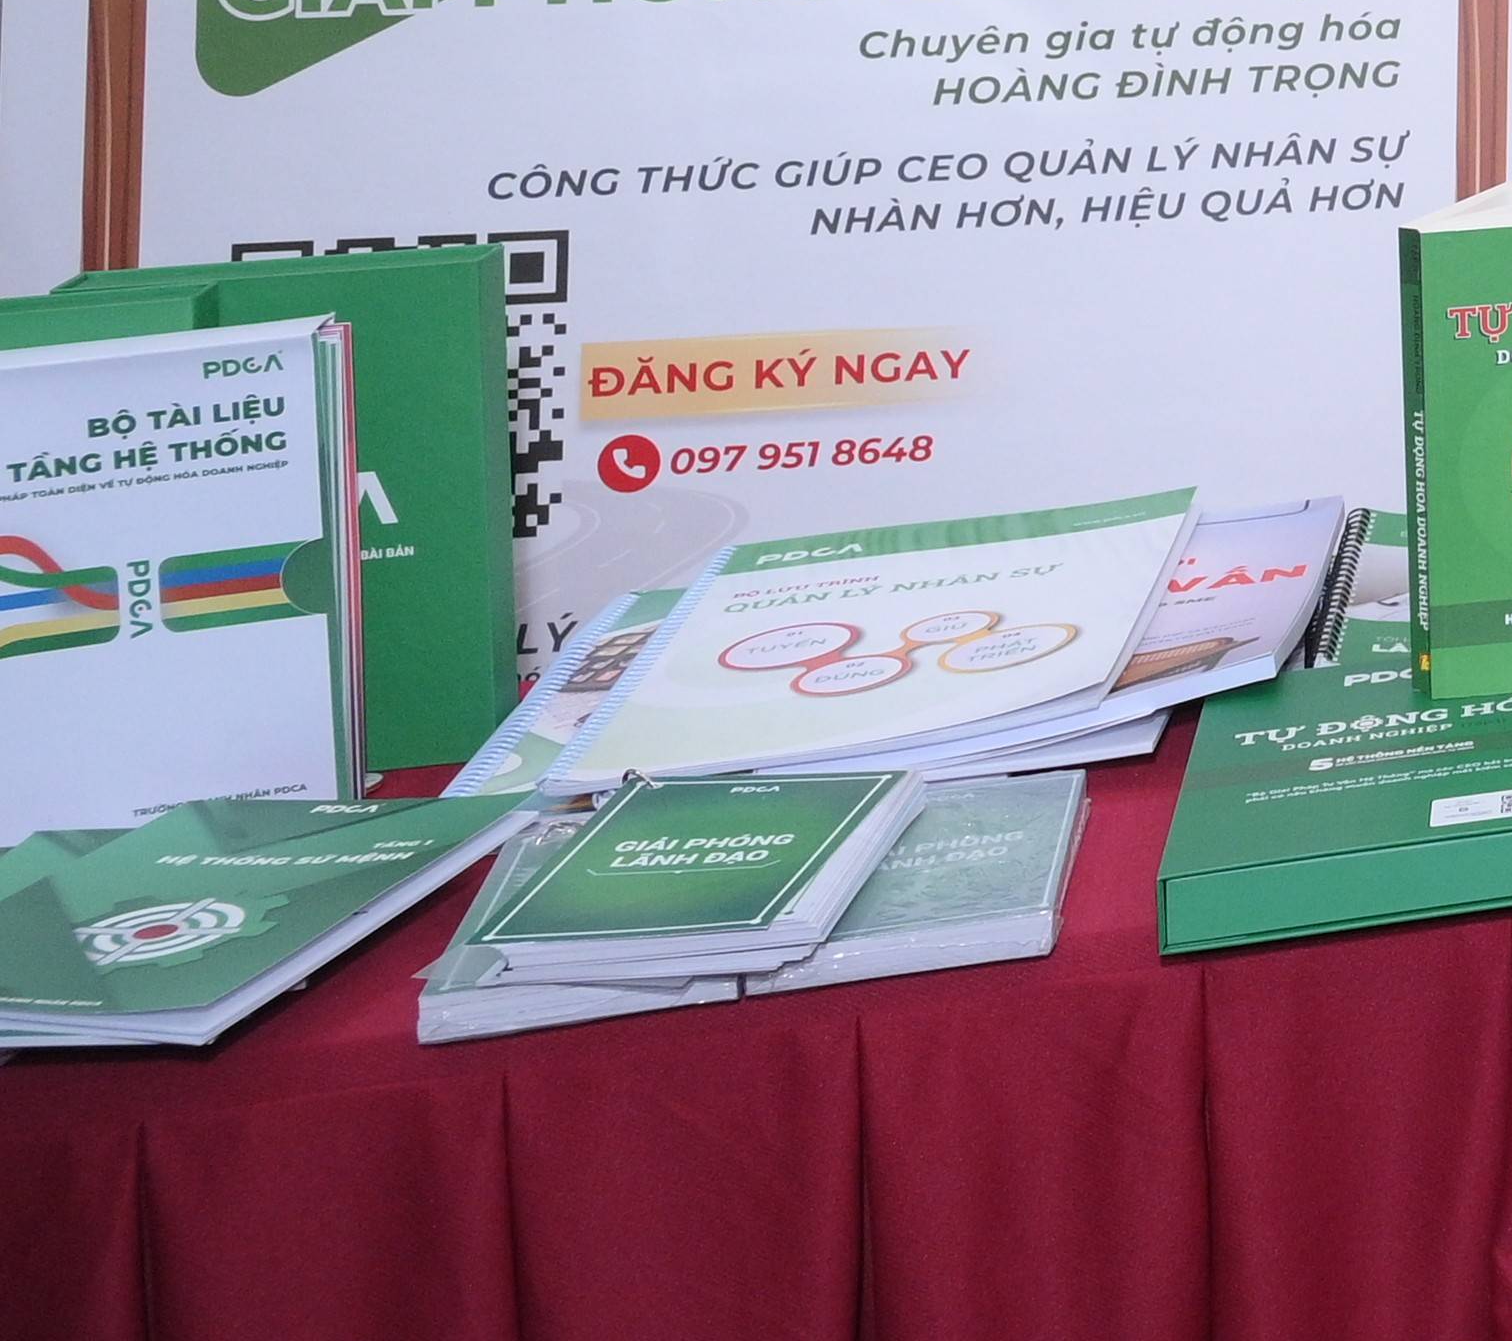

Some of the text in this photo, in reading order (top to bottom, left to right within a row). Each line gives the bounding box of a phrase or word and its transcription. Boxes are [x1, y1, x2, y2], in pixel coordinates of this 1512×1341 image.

[859, 12, 1400, 63] Chuyên gia tự động hóa
[933, 60, 1400, 105] HOÀNG ĐÌNH TRỌNG
[488, 130, 1411, 201] CÔNG THỨC GIÚP CEO QUẢN LÝ NHÂN SỰ
[809, 177, 1405, 235] NHÀN HƠN, HIỆU QUẢ HƠN
[588, 348, 971, 398] ĐĂNG KÝ NGAY
[88, 394, 285, 440] BỘ TÀI LIỆU
[6, 428, 287, 483] TẦNG HỆ THỐNG
[670, 435, 934, 475] 097 951 8648
[1235, 724, 1306, 747] TỰ
[1281, 723, 1454, 751] DOANH NGHIỆP
[1308, 757, 1335, 772] 5
